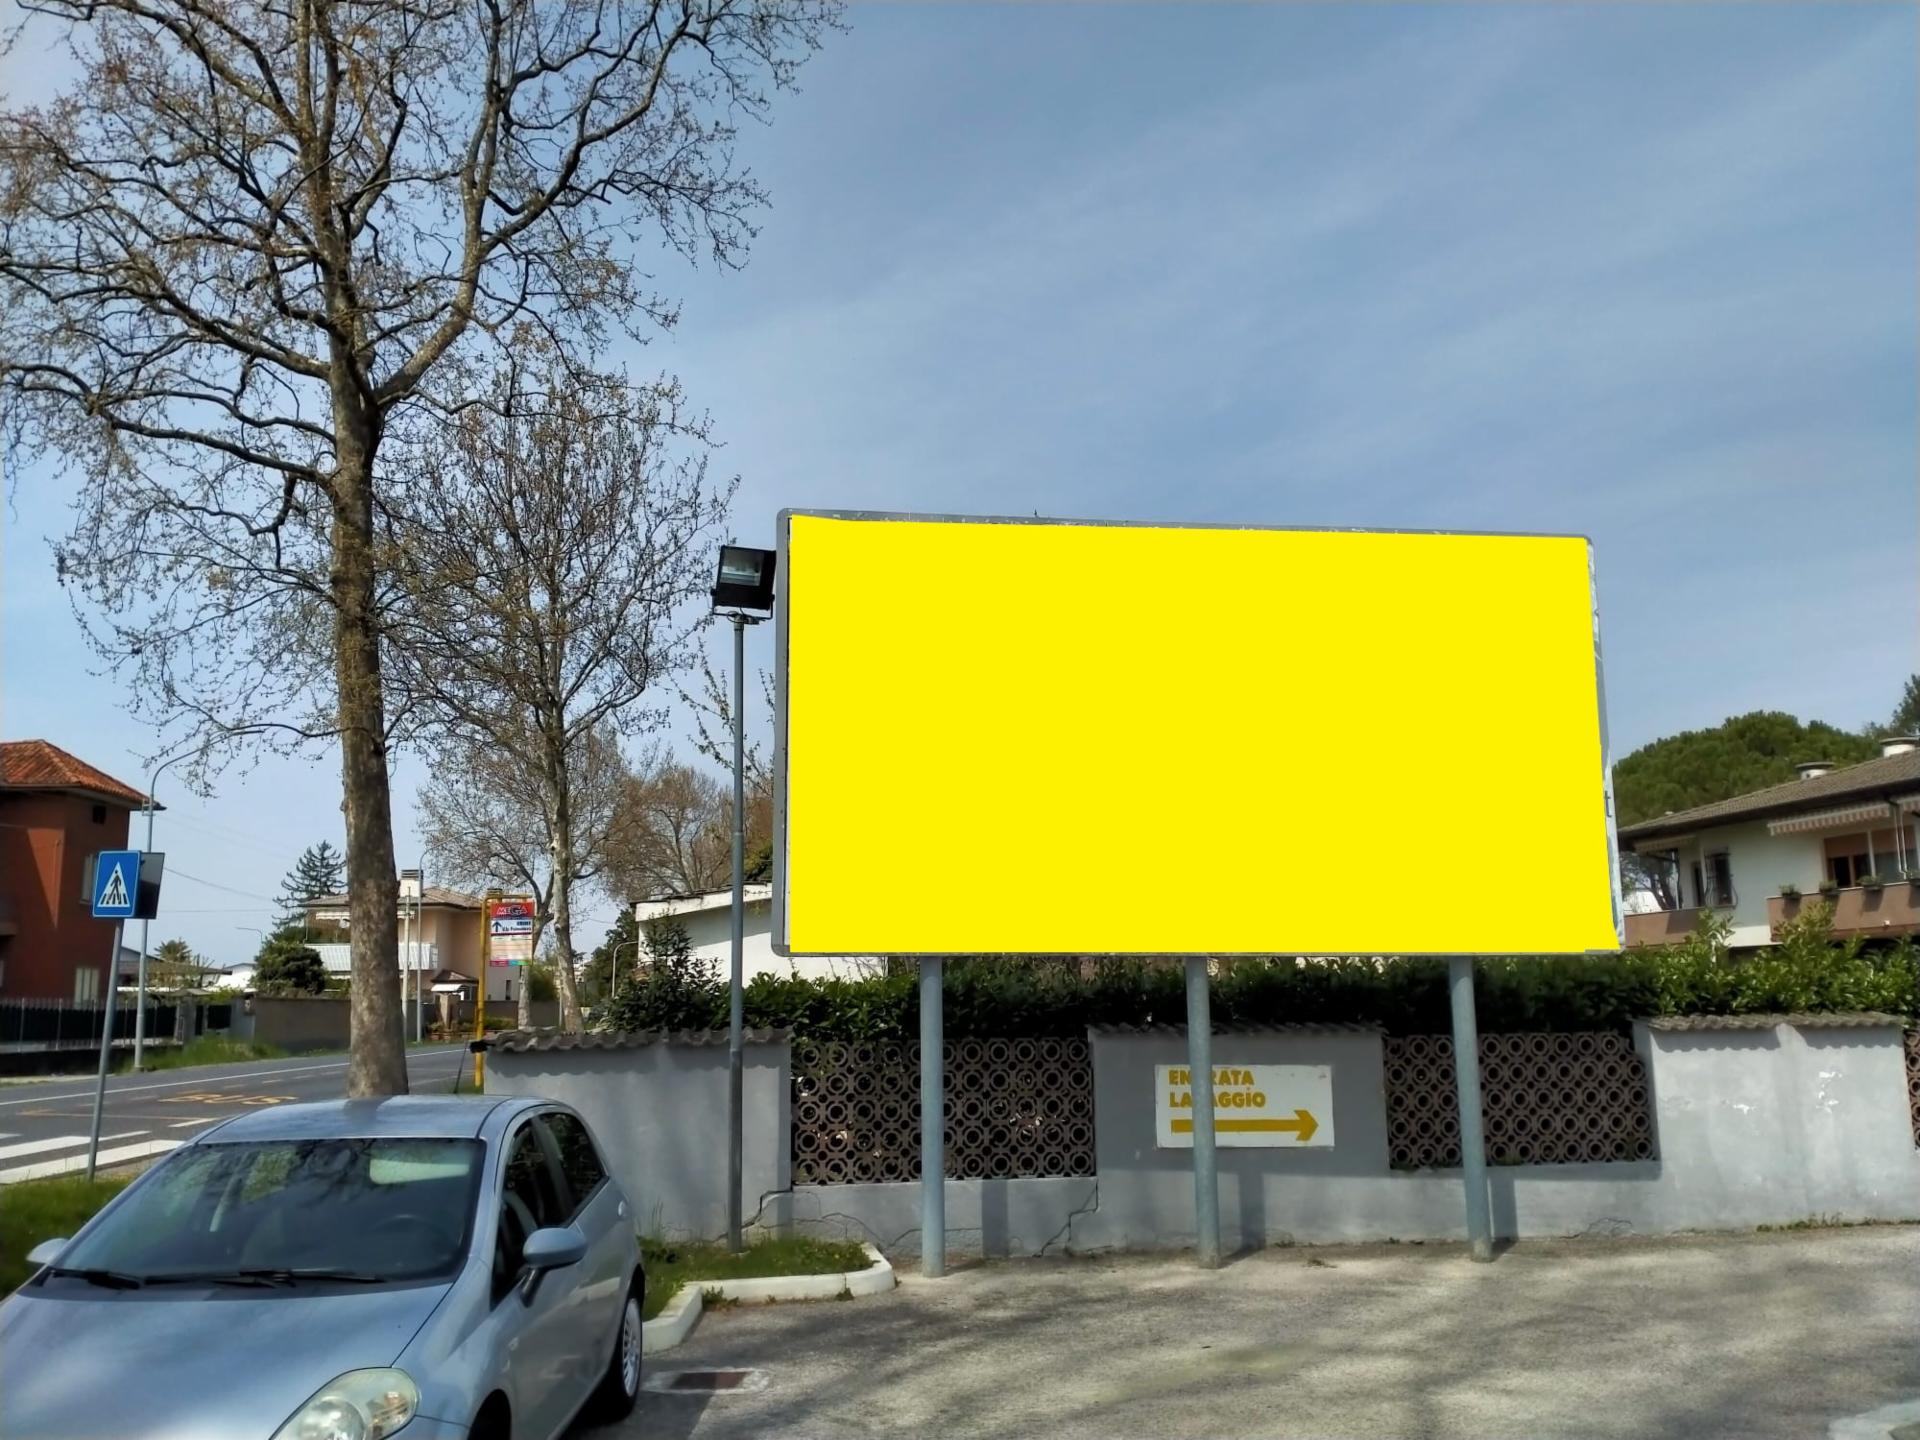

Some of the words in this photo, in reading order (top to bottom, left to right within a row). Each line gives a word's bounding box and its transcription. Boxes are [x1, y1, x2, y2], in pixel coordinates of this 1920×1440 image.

[497, 905, 528, 916] MEGA
[1168, 1069, 1255, 1086] ENATA
[157, 1090, 299, 1105] BUS
[1169, 1090, 1266, 1108] LAGGIO
